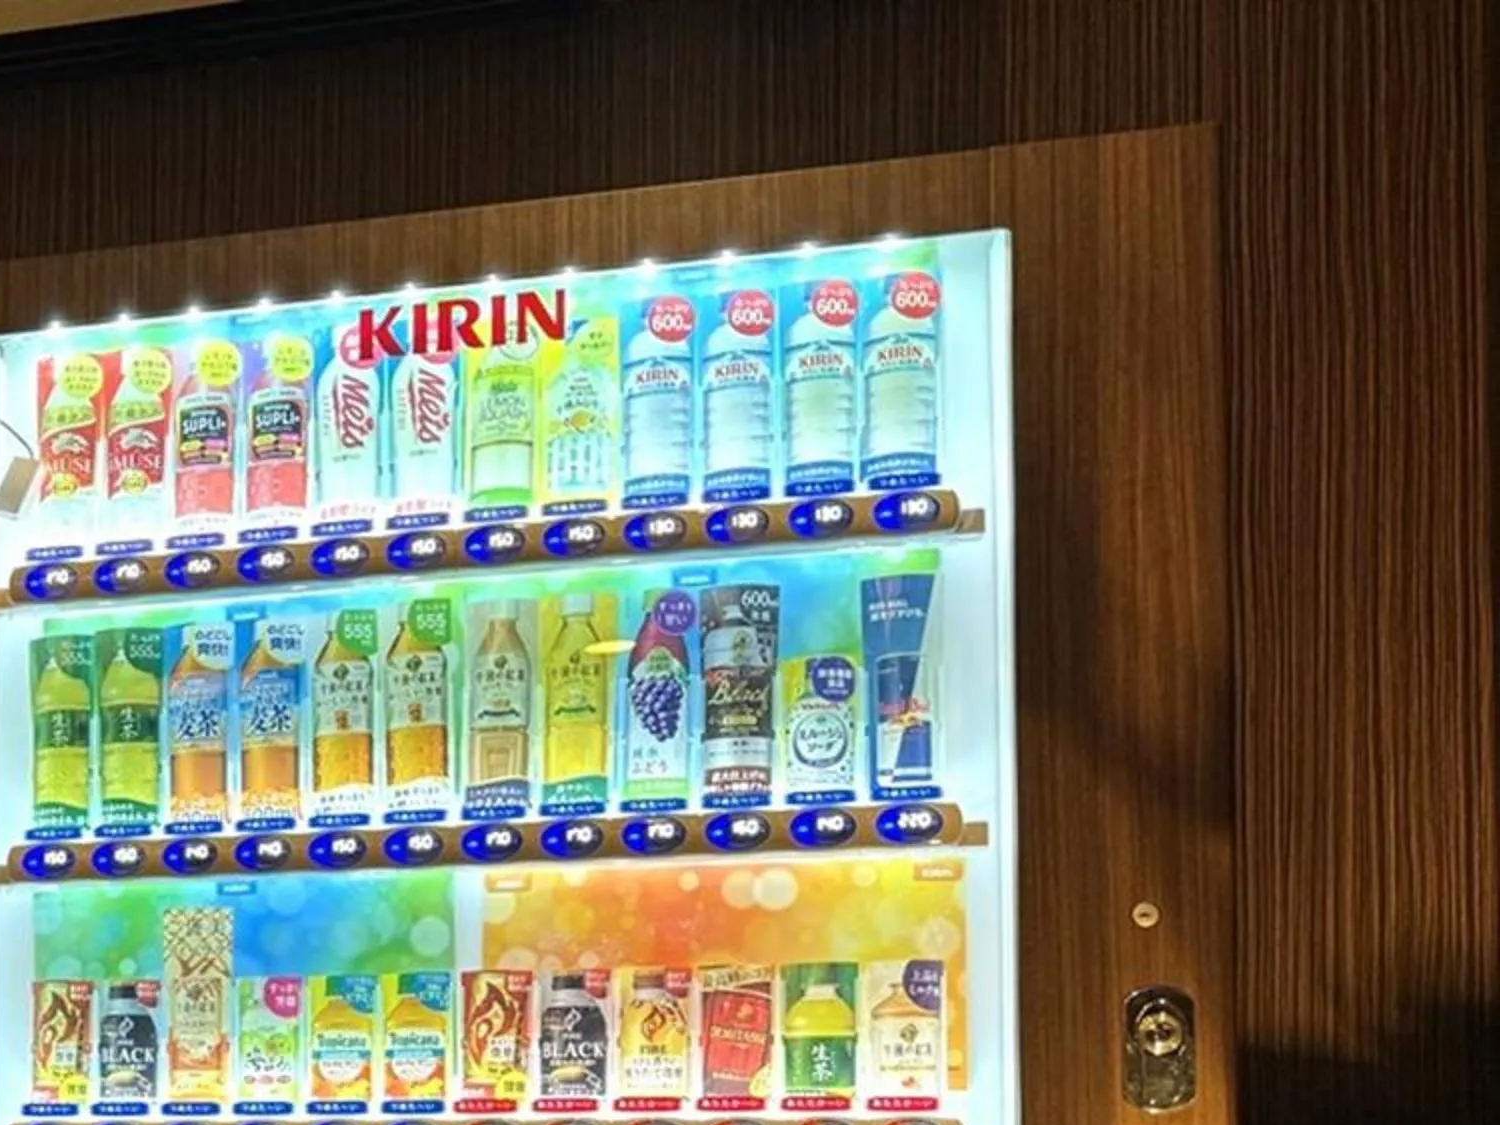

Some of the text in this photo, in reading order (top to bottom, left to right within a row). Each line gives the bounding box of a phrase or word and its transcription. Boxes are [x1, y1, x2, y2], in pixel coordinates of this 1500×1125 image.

[359, 289, 566, 360] KIRIN
[799, 352, 844, 367] KIRIN
[877, 345, 923, 360] KIRIN
[635, 368, 679, 384] KIRIN
[714, 361, 759, 378] KIRIN
[195, 628, 233, 641] のどごし
[267, 624, 305, 636] のどごし
[118, 706, 139, 739] 生茶
[178, 707, 220, 739] 麦茶
[250, 704, 292, 735] 麦茶
[50, 711, 70, 746] 生茶
[317, 1033, 367, 1048] Tropicana
[389, 1032, 441, 1047] Tropicana
[99, 1047, 155, 1063] BLACK
[542, 1040, 605, 1058] BLACK
[810, 1042, 834, 1082] 生茶
